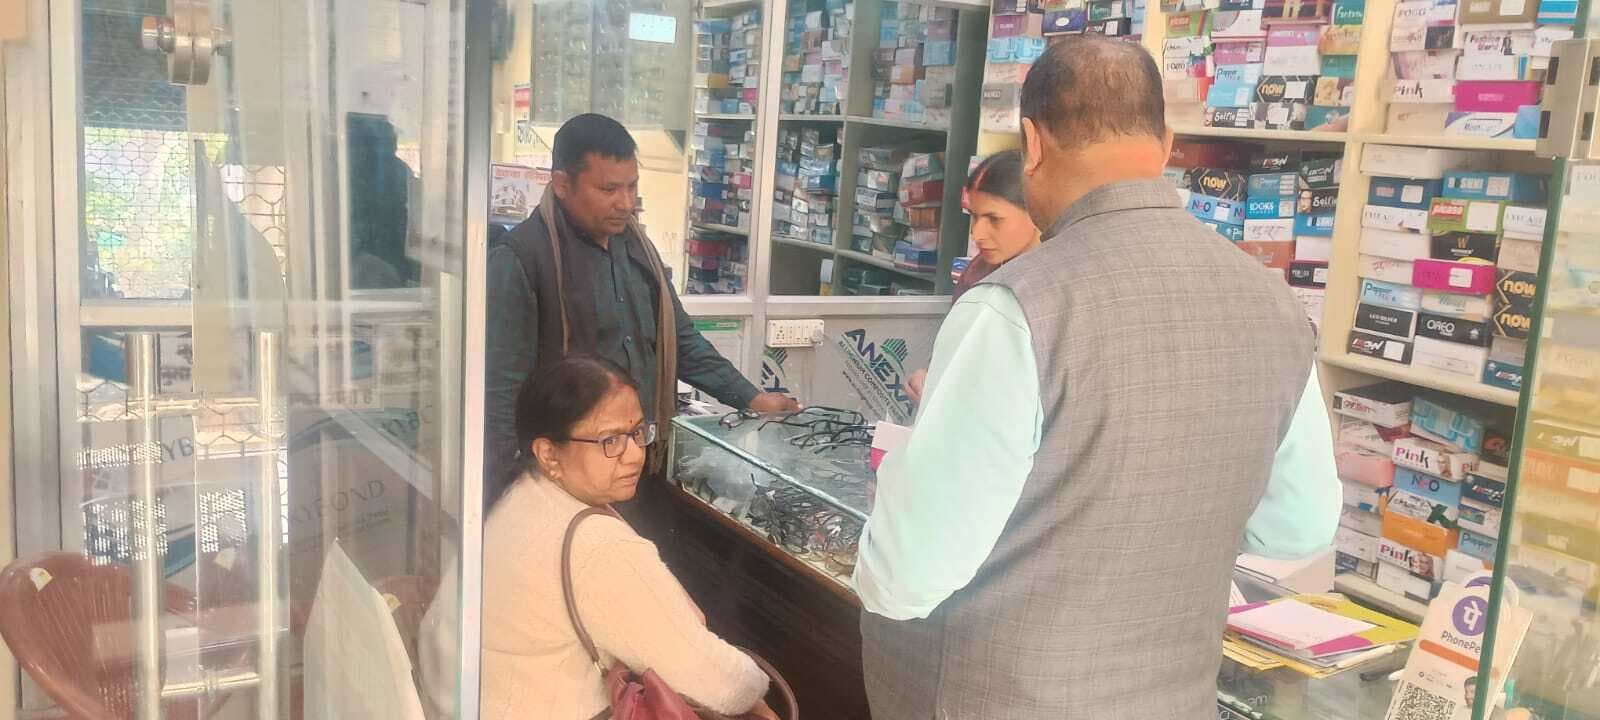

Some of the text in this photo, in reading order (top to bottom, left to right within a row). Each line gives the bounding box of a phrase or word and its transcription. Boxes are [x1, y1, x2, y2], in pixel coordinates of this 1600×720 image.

[1261, 83, 1284, 96] now
[1394, 80, 1424, 99] Pink
[1203, 176, 1227, 190] now
[1503, 280, 1536, 296] now
[1395, 446, 1429, 469] Pink
[1380, 543, 1413, 568] Pink
[1441, 630, 1481, 654] PhonePe
